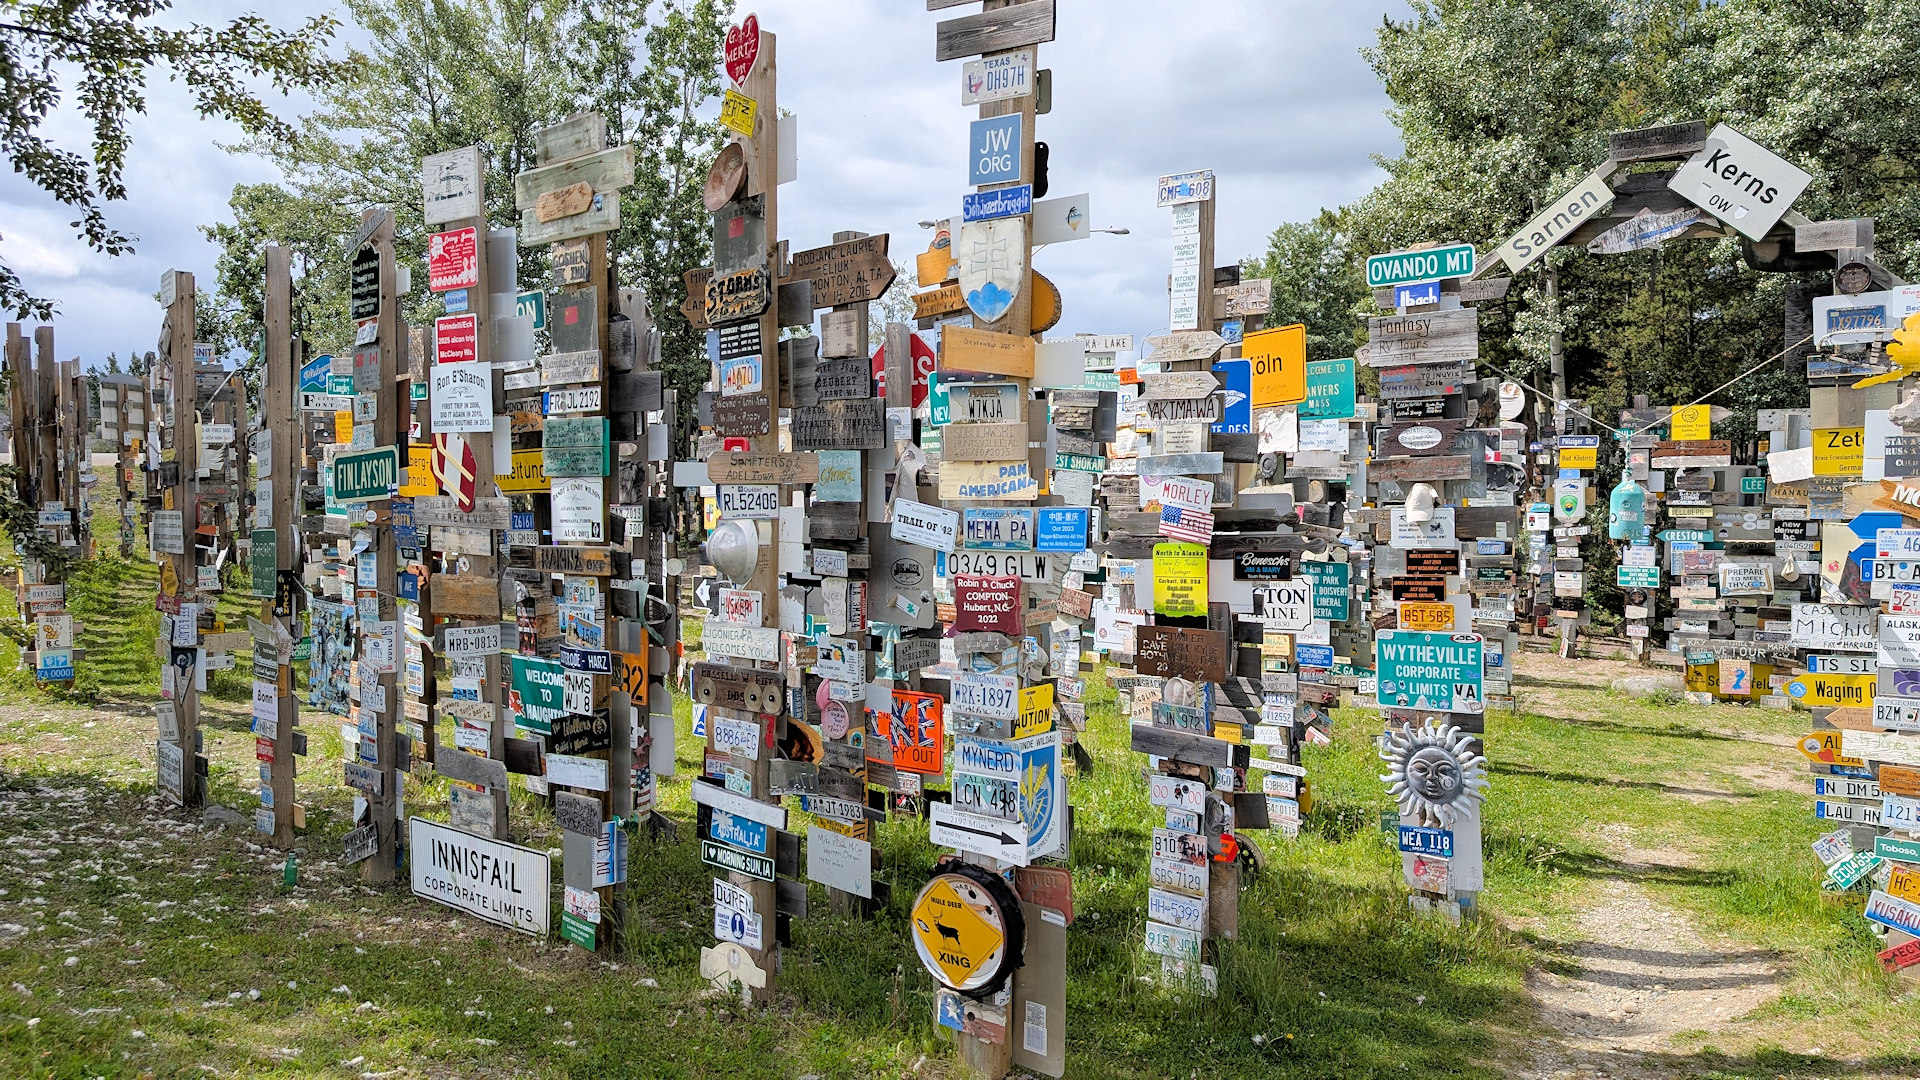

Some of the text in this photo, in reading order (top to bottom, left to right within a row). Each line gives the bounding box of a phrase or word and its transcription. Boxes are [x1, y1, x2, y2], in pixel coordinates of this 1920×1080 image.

[726, 39, 757, 63] MERTZ
[984, 56, 1010, 70] TEXAS
[986, 66, 1025, 92] DH97H
[980, 126, 1012, 154] JW
[976, 154, 1012, 175] .ORG
[1704, 148, 1780, 205] Kerns
[1160, 181, 1210, 202] CMF 608
[1708, 192, 1734, 214] OW
[1512, 189, 1600, 258] Sarnen
[553, 250, 586, 266] GOSHEN
[818, 241, 874, 262] AND LAURIE
[1372, 250, 1470, 282] OVANDO MT
[856, 268, 882, 284] ALTA
[1174, 274, 1196, 284] KITCHEN
[1175, 280, 1194, 288] FAMILY
[1468, 280, 1496, 290] SHAW
[850, 284, 871, 300] 2016
[1468, 290, 1496, 300] 2004
[1377, 318, 1432, 338] Fantasy
[466, 336, 475, 345] trip
[1104, 338, 1127, 348] LAKE
[1378, 340, 1430, 354] RV Tours
[440, 348, 463, 358] McCleary
[1336, 364, 1346, 372] TO
[436, 370, 486, 392] Ron Sharon
[818, 376, 858, 388] SEUBERT
[1381, 384, 1420, 392] CYNTHIA
[442, 402, 452, 410] FIRST
[550, 390, 600, 409] FR JL 2192
[1308, 400, 1330, 408] MASS
[968, 400, 1002, 418] W7KJA
[842, 438, 865, 446] IDAHO
[1070, 458, 1104, 472] SHOKAN
[1574, 454, 1594, 462] Köstritz
[337, 456, 393, 492] FINLAYSON
[726, 470, 749, 481] ADEL
[1000, 464, 1027, 479] PAN
[584, 484, 600, 500] WILSON
[959, 477, 1036, 497] AMERICANA
[1162, 482, 1210, 506] MORLEY
[1774, 488, 1809, 498] HANAU
[513, 515, 534, 528] Z6161
[981, 510, 1016, 519] Kentucky
[897, 514, 938, 532] TRAIL OF
[967, 520, 1028, 540] MEMA PA
[1665, 531, 1704, 541] CRESTON
[1774, 527, 1804, 535] denver
[815, 556, 846, 570] 665 XDT
[949, 553, 1046, 579] 0349 GLW
[1240, 552, 1290, 566] Beneschs
[1727, 568, 1764, 576] PREPARE
[1875, 564, 1896, 579] BI
[957, 579, 1015, 590] Robin Chuck
[1322, 576, 1340, 585] PARK
[966, 592, 1009, 601] COMPTON
[1319, 587, 1348, 596] BOISVERT
[1893, 590, 1911, 606] 52
[962, 602, 994, 612] Hubert,
[1316, 598, 1342, 608] LIBERAL
[1801, 605, 1834, 616] CASS
[977, 614, 998, 624] 2022
[449, 634, 498, 652] HRB 0813
[582, 627, 599, 647] 1599
[704, 642, 746, 656] WELCOMES
[907, 650, 930, 660] HOLDEN
[1382, 643, 1477, 666] WYTHEVILLE
[1732, 646, 1766, 658] TOUR
[588, 655, 608, 670] HARZ
[1819, 659, 1869, 672] TS SI
[526, 668, 564, 687] WELCOME
[701, 668, 736, 681] RUSSELL
[967, 674, 1000, 685] VIRGINIA
[1395, 665, 1461, 680] CORPORATE
[568, 676, 591, 693] NMS
[1408, 682, 1448, 696] LIMITS
[1454, 684, 1477, 699] VA
[1815, 680, 1862, 703] Waging
[258, 690, 274, 704] Bonn
[540, 689, 552, 702] TO
[728, 690, 744, 702] DDS
[1877, 705, 1901, 720] BZM
[1157, 710, 1200, 731] LJN 972
[716, 726, 757, 750] 8886 EG
[1217, 728, 1240, 738] Vogtland
[970, 737, 998, 747] ALASKA
[1036, 735, 1056, 747] WILDAU
[912, 749, 936, 765] OUT
[962, 746, 1014, 772] MYNERD
[968, 776, 1004, 788] ALASKA
[1847, 783, 1866, 796] DM
[955, 782, 981, 807] LCN
[838, 804, 861, 819] 1983
[1279, 804, 1296, 816] 0115
[1826, 804, 1881, 823] LAU HN
[1887, 805, 1911, 821] 121
[968, 818, 988, 831] Miles
[716, 824, 761, 849] AUSTRALIA
[1402, 831, 1450, 850] WEA 118
[1154, 836, 1176, 854] 810
[1820, 844, 1842, 861] GKY
[1880, 843, 1918, 856] Toboso,
[432, 838, 522, 894] INNISFAIL
[717, 848, 762, 875] MORNING SUN,
[1154, 868, 1201, 891] SBS 7129
[424, 876, 533, 922] CORPORATE LIMITS
[930, 896, 963, 909] MULE DEER
[1148, 930, 1170, 946] 915
[938, 950, 972, 969] XING
